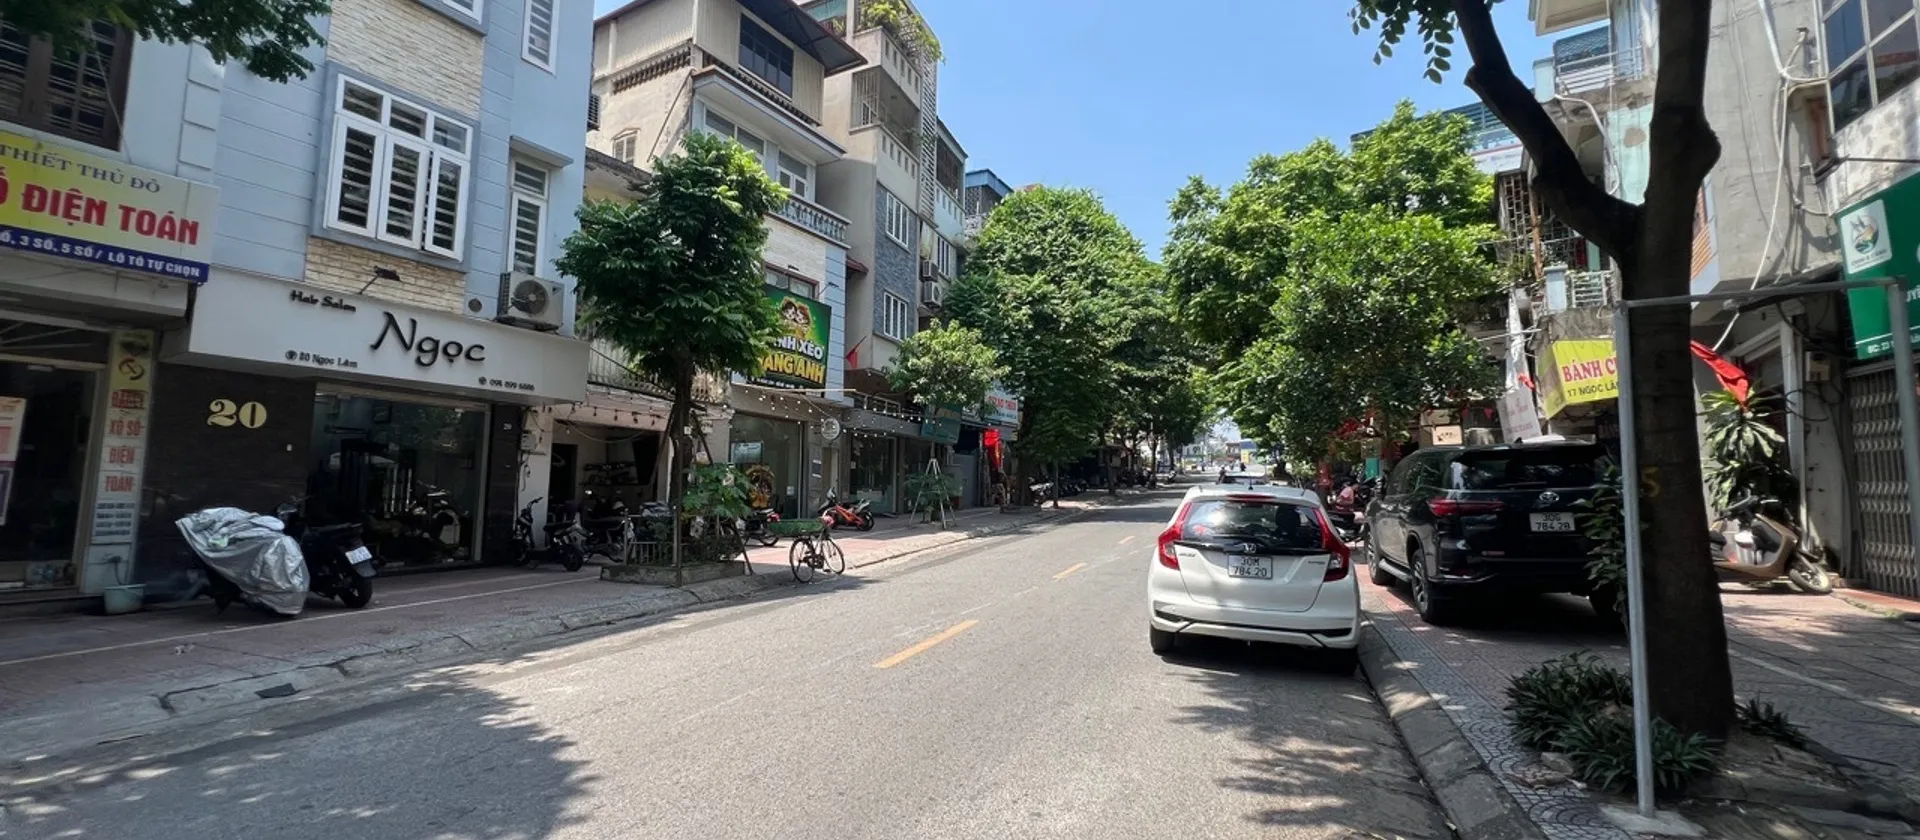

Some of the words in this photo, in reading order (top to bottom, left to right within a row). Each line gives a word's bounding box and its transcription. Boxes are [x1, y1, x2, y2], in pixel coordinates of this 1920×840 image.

[76, 163, 125, 185] THỦ
[130, 177, 161, 193] ĐÔ
[21, 183, 107, 226] ĐIỆN
[118, 204, 200, 245] TOÁN
[19, 236, 29, 246] 3
[61, 243, 71, 253] 5
[148, 258, 164, 272] TỰ
[165, 262, 200, 278] CHỌN
[289, 289, 319, 305] Hair
[321, 296, 357, 312] Salon
[369, 310, 486, 367] Ngọc
[299, 352, 311, 362] 20
[795, 357, 826, 384] ANH
[1561, 359, 1603, 382] BÁNH
[1567, 388, 1577, 397] 17
[206, 398, 267, 428] 20
